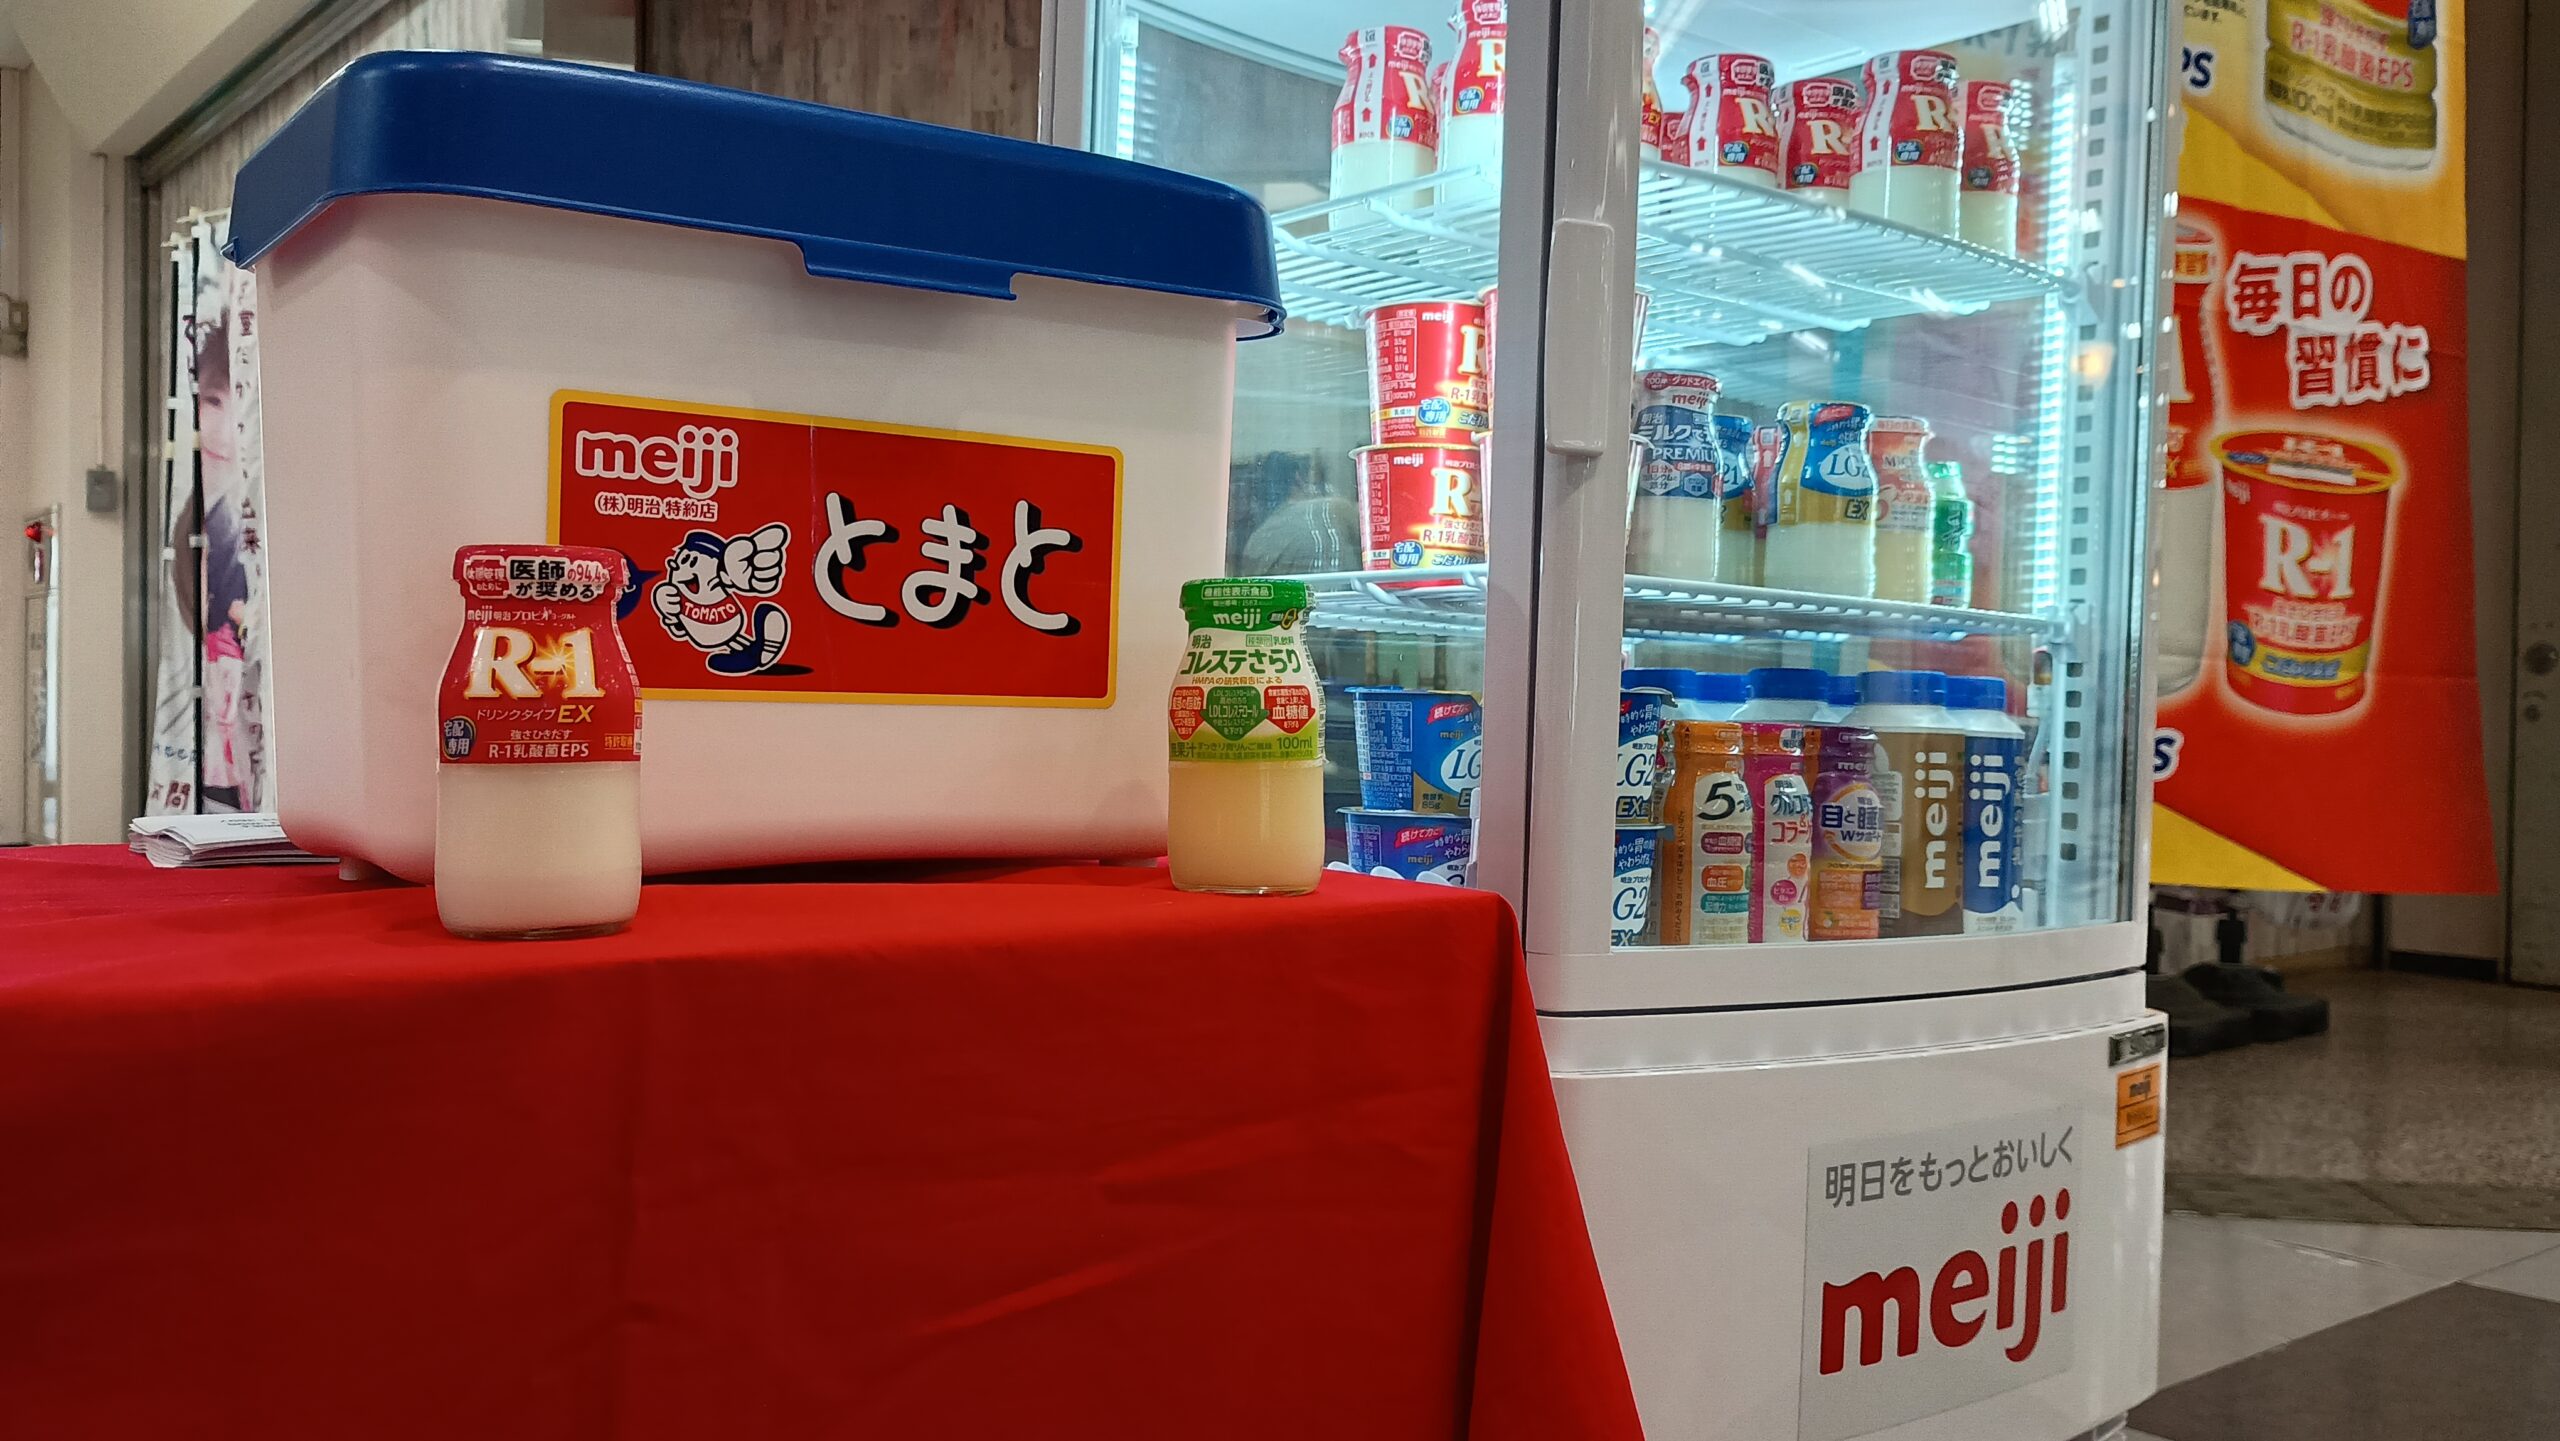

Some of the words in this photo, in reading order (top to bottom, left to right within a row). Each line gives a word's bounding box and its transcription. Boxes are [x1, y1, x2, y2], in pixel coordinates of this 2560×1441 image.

[1911, 95, 1953, 132] R
[1806, 120, 1849, 155] R
[2231, 260, 2367, 328] 毎日の
[1422, 311, 1454, 324] meiji
[2293, 329, 2427, 402] 習慣に
[1672, 392, 1709, 409] meiji
[577, 425, 738, 498] meiji
[1393, 453, 1424, 467] meiji
[1429, 467, 1475, 519] R
[595, 495, 661, 518] (株)明治
[664, 497, 718, 522] 特約店
[813, 492, 1080, 635] とまと
[2259, 514, 2355, 599] R-1
[467, 604, 493, 625] meiji
[683, 600, 738, 623] TOMATO
[1213, 607, 1262, 629] meiji
[1191, 634, 1213, 649] 明治
[463, 627, 607, 700] R-1
[1180, 649, 1302, 675] コレステさらり
[1208, 705, 1259, 719] LDLコレステロール
[1272, 706, 1309, 720] 血糖値
[444, 720, 465, 737] 宅配
[510, 729, 573, 740] 強さひきだす
[1440, 730, 1463, 741] meiji
[447, 738, 471, 755] 専用
[488, 743, 589, 758] R-1乳酸菌EPS
[1277, 736, 1313, 750] 100ml
[1914, 751, 1955, 888] meiji
[1968, 754, 2011, 888] meiji
[1408, 854, 1434, 864] meiji
[1825, 1125, 2073, 1209] 明日をもっとおいしく
[1819, 1187, 2071, 1376] meiji
